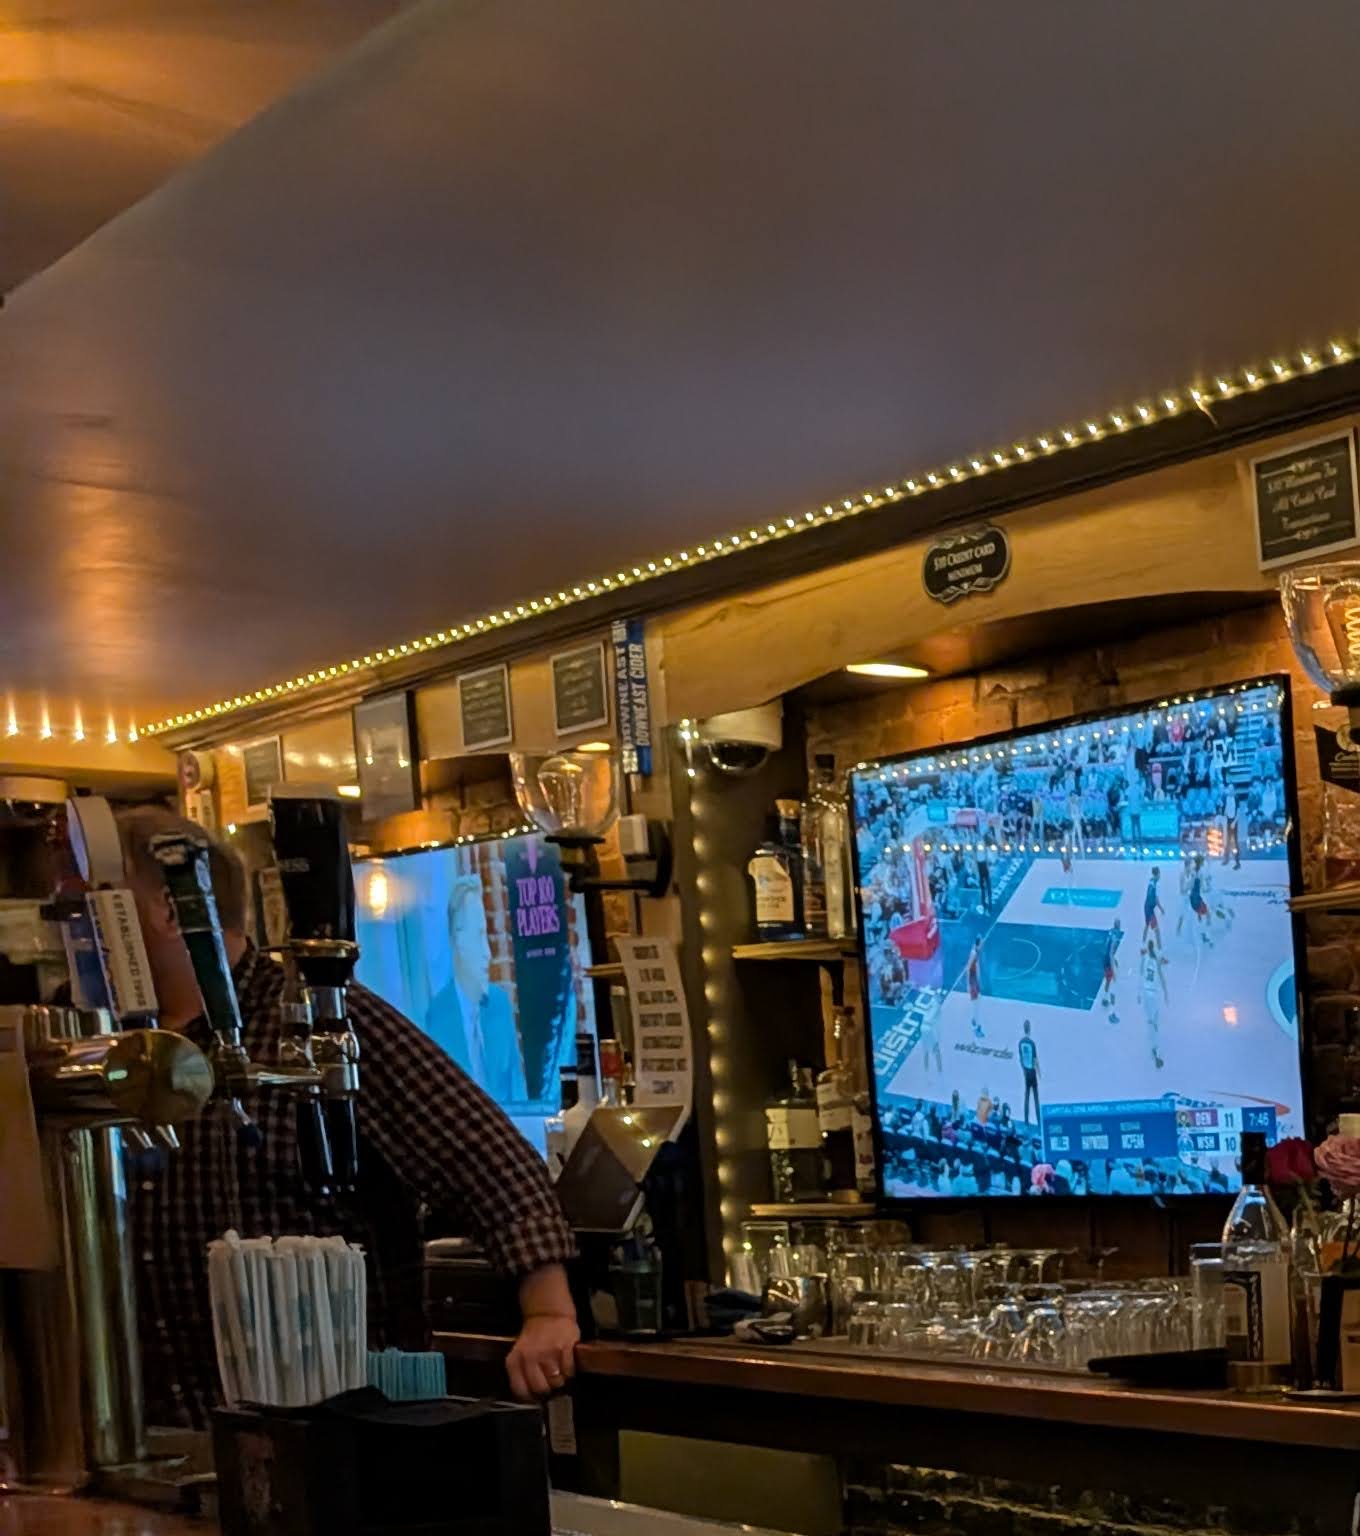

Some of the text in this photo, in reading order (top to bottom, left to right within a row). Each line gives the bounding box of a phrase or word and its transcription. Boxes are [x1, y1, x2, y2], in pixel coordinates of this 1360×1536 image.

[516, 877, 537, 907] TOP
[517, 904, 560, 937] PLAYERS
[1224, 1112, 1235, 1128] 11
